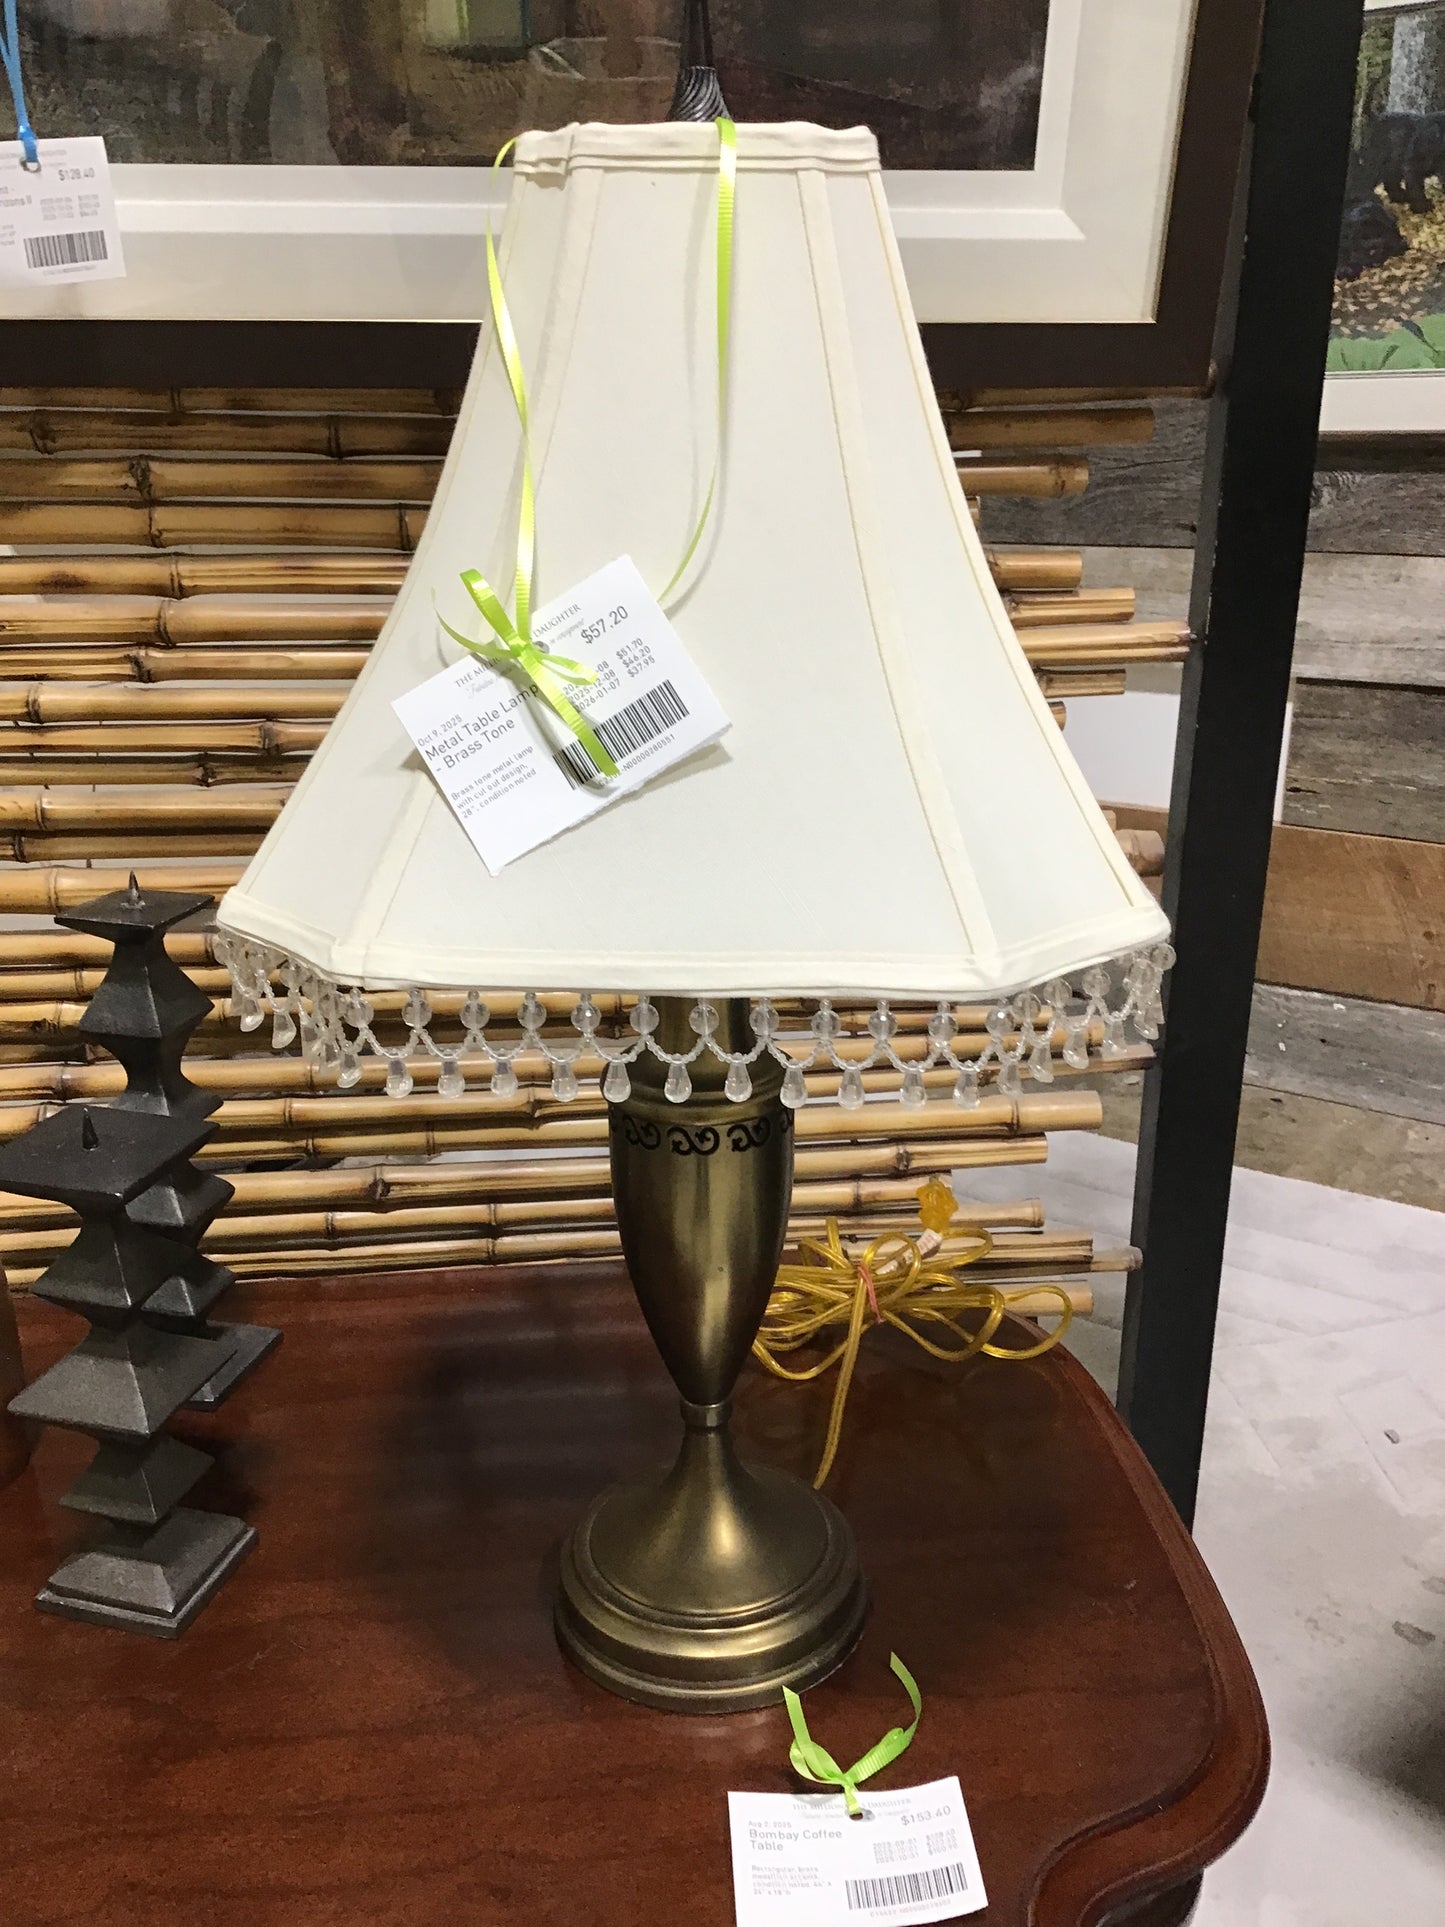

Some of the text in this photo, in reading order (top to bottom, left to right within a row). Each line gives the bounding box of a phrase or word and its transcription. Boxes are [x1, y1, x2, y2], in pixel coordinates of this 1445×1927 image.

[533, 604, 582, 638] DAUGHTER
[580, 605, 628, 644] $57.20
[616, 638, 644, 660] $51.70
[622, 646, 652, 668] $46.20
[456, 672, 473, 688] THE
[418, 734, 432, 748] Oct
[441, 714, 462, 732] 2025
[424, 732, 463, 761] Metal
[462, 709, 500, 736] Table
[500, 684, 539, 713] Lamp
[443, 738, 482, 769] Brass
[482, 718, 516, 742] Tone
[451, 746, 534, 800] Brass tone metal lamp
[480, 783, 514, 806] condition
[516, 768, 536, 786] noted
[457, 796, 473, 810] with
[474, 788, 487, 799] cut
[488, 780, 500, 790] out
[901, 1805, 951, 1826] $153.40
[749, 1828, 842, 1841] Bombay Coffee
[750, 1840, 784, 1851] Table
